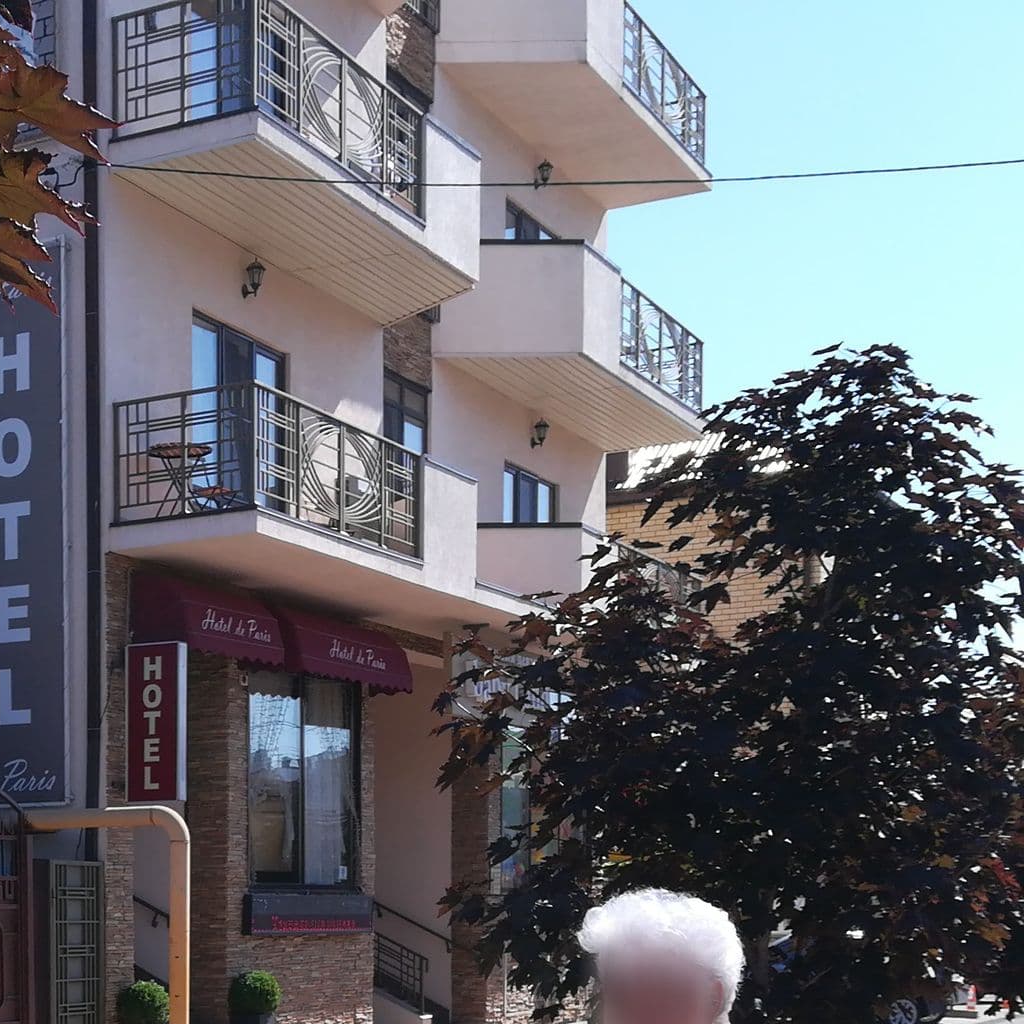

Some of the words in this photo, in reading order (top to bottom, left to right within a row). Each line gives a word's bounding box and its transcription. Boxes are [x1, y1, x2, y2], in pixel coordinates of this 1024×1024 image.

[201, 608, 232, 634] Hotel
[235, 619, 245, 636] de
[247, 619, 271, 643] Paris
[329, 639, 353, 661] Hotel
[356, 650, 365, 665] de
[366, 648, 387, 671] Paris
[142, 655, 163, 791] HOTEL
[0, 758, 57, 793] Paris
